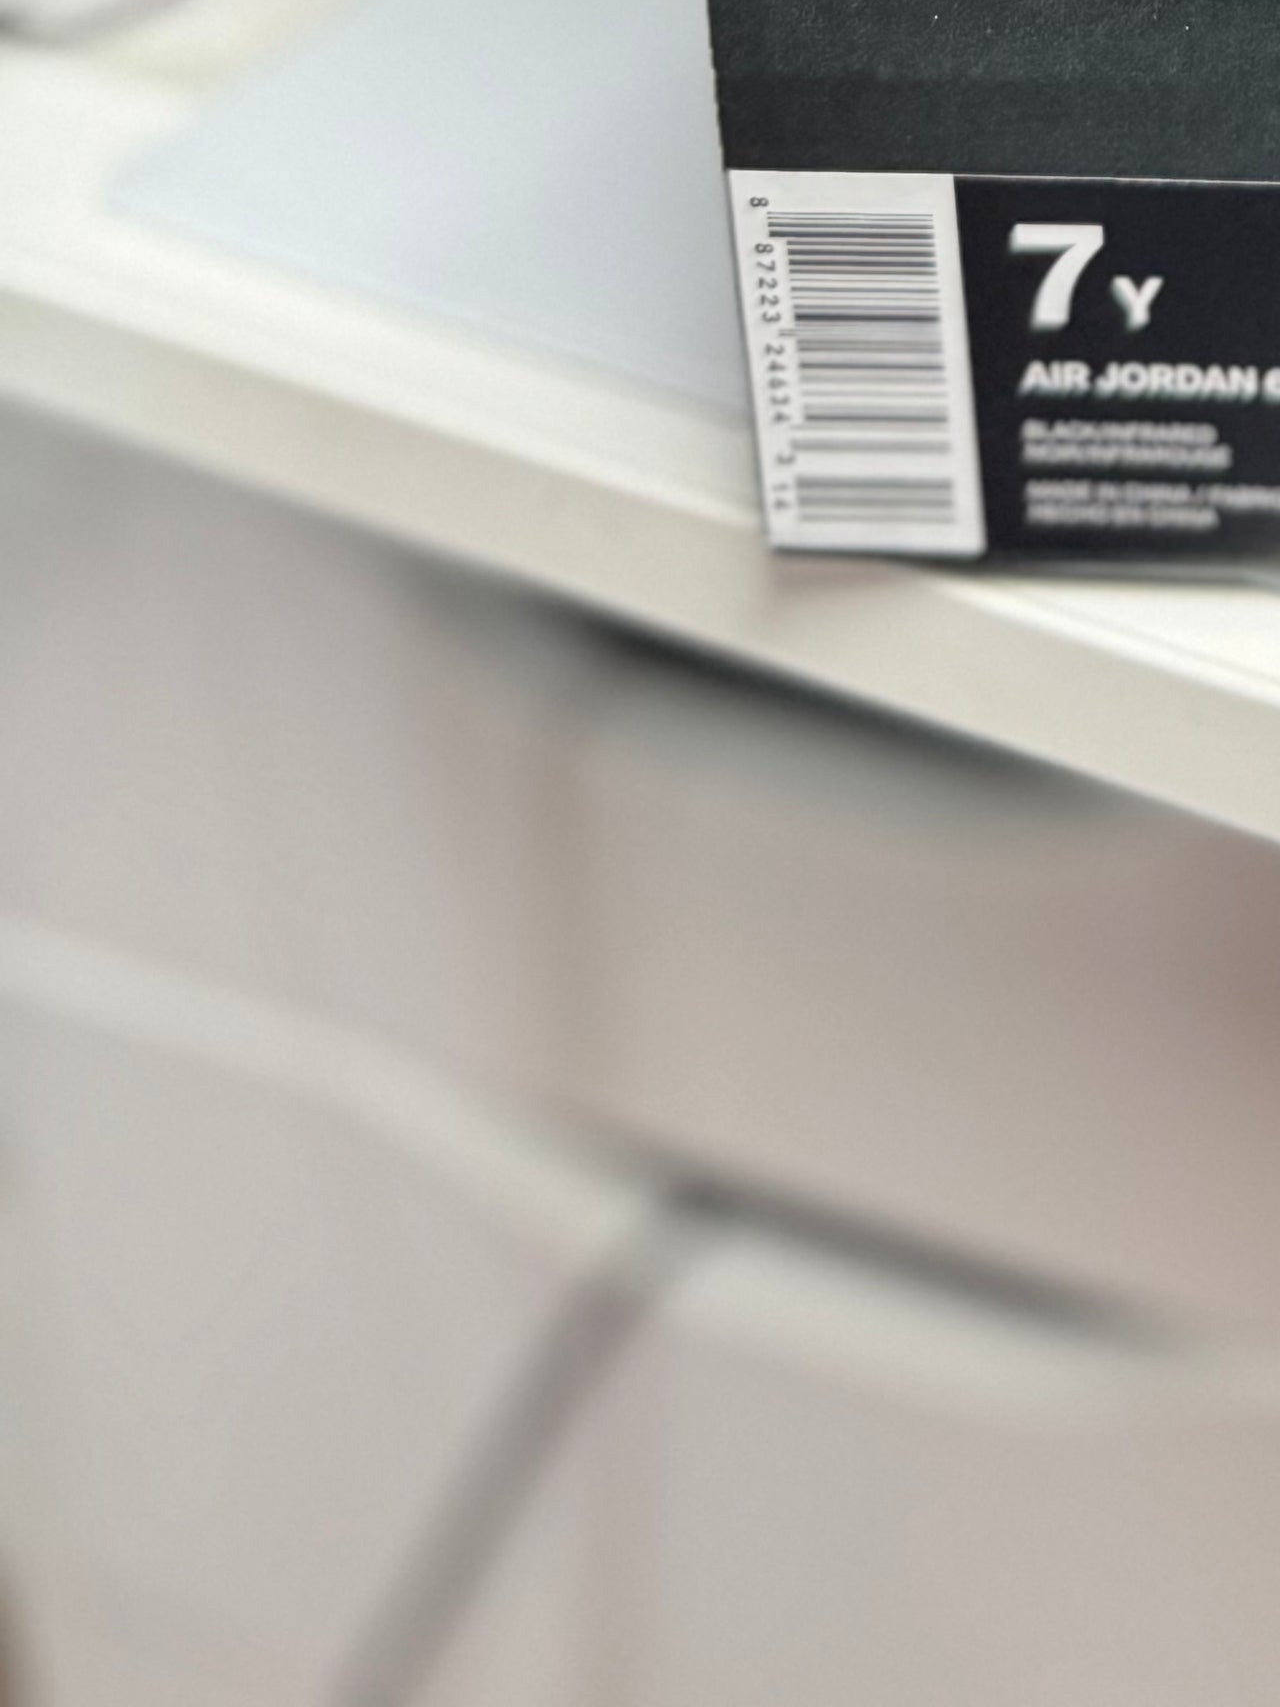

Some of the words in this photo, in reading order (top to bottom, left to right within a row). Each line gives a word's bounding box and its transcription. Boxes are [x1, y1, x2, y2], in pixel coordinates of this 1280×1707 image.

[1010, 223, 1104, 330] 7
[1112, 276, 1163, 331] Y
[1020, 360, 1091, 395] AIR
[1093, 363, 1259, 400] JORDAN
